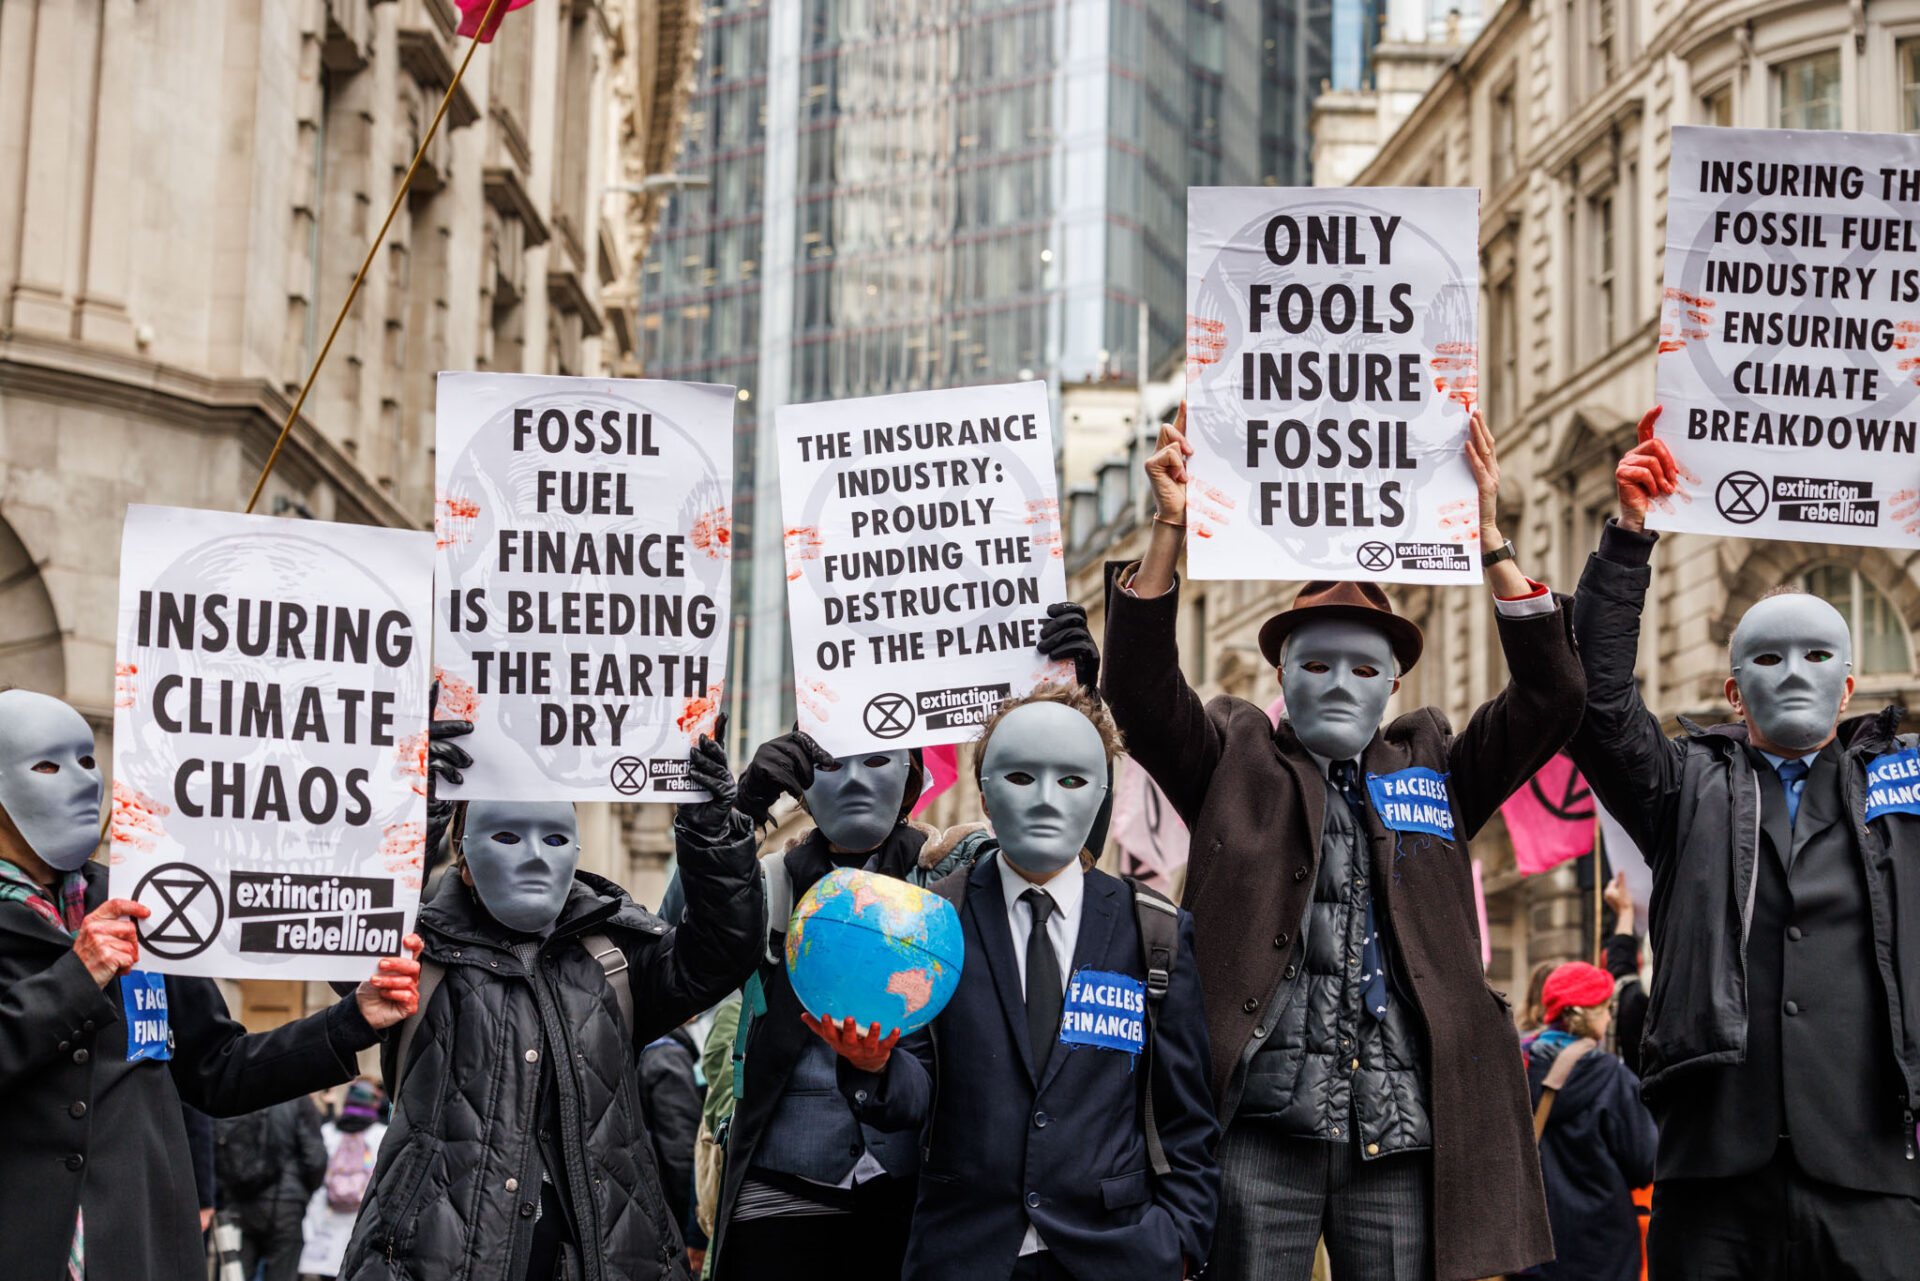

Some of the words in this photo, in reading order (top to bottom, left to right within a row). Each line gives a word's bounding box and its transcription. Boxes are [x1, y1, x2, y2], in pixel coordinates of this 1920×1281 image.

[1699, 160, 1865, 200] INSURING
[1879, 167, 1920, 203] TH
[1264, 214, 1402, 266] ONLY
[1714, 210, 1827, 248] FOSSIL
[1841, 216, 1917, 253] FUEL
[1705, 260, 1877, 301] INDUSTRY
[1890, 269, 1920, 303] IS
[1249, 282, 1414, 335] FOOLS
[1723, 310, 1895, 353] ENSURING
[1242, 351, 1421, 403] INSURE
[1733, 360, 1879, 402] CLIMATE
[513, 408, 660, 456] FOSSIL
[797, 432, 852, 462] THE
[863, 414, 1037, 455] INSURANCE
[1246, 418, 1417, 470] FOSSIL
[1687, 408, 1917, 454] BREAKDOWN
[537, 470, 634, 516] FUEL
[837, 457, 1005, 499] INDUSTRY:
[1776, 479, 1859, 500] extinction
[851, 497, 994, 538] PROUDLY
[1260, 480, 1405, 528] FUELS
[1799, 500, 1876, 525] rebellion
[499, 529, 685, 578] FINANCE
[824, 542, 963, 583] FUNDING
[975, 536, 1032, 566] THE
[1398, 543, 1455, 556] extinction
[1416, 556, 1468, 570] rebellion
[450, 588, 488, 633] IS
[508, 590, 716, 639] BLEEDING
[824, 577, 1039, 626] DESTRUCTION
[137, 590, 413, 668] INSURING
[817, 639, 856, 671] OF
[868, 631, 925, 665] THE
[471, 651, 551, 695] THE
[570, 653, 709, 699] EARTH
[152, 674, 395, 747] CLIMATE
[921, 686, 998, 710] extinction
[946, 704, 998, 726] rebelli
[540, 703, 630, 746] DRY
[651, 760, 691, 774] extincti
[666, 776, 704, 790] rebel
[1868, 758, 1920, 788] ACELE
[174, 758, 372, 826] CHAOS
[1383, 777, 1449, 802] FACELESS
[1384, 803, 1455, 830] FINANCIER
[236, 874, 372, 911] extinction
[276, 913, 398, 953] rebellion
[1071, 982, 1144, 1013] FACELESS
